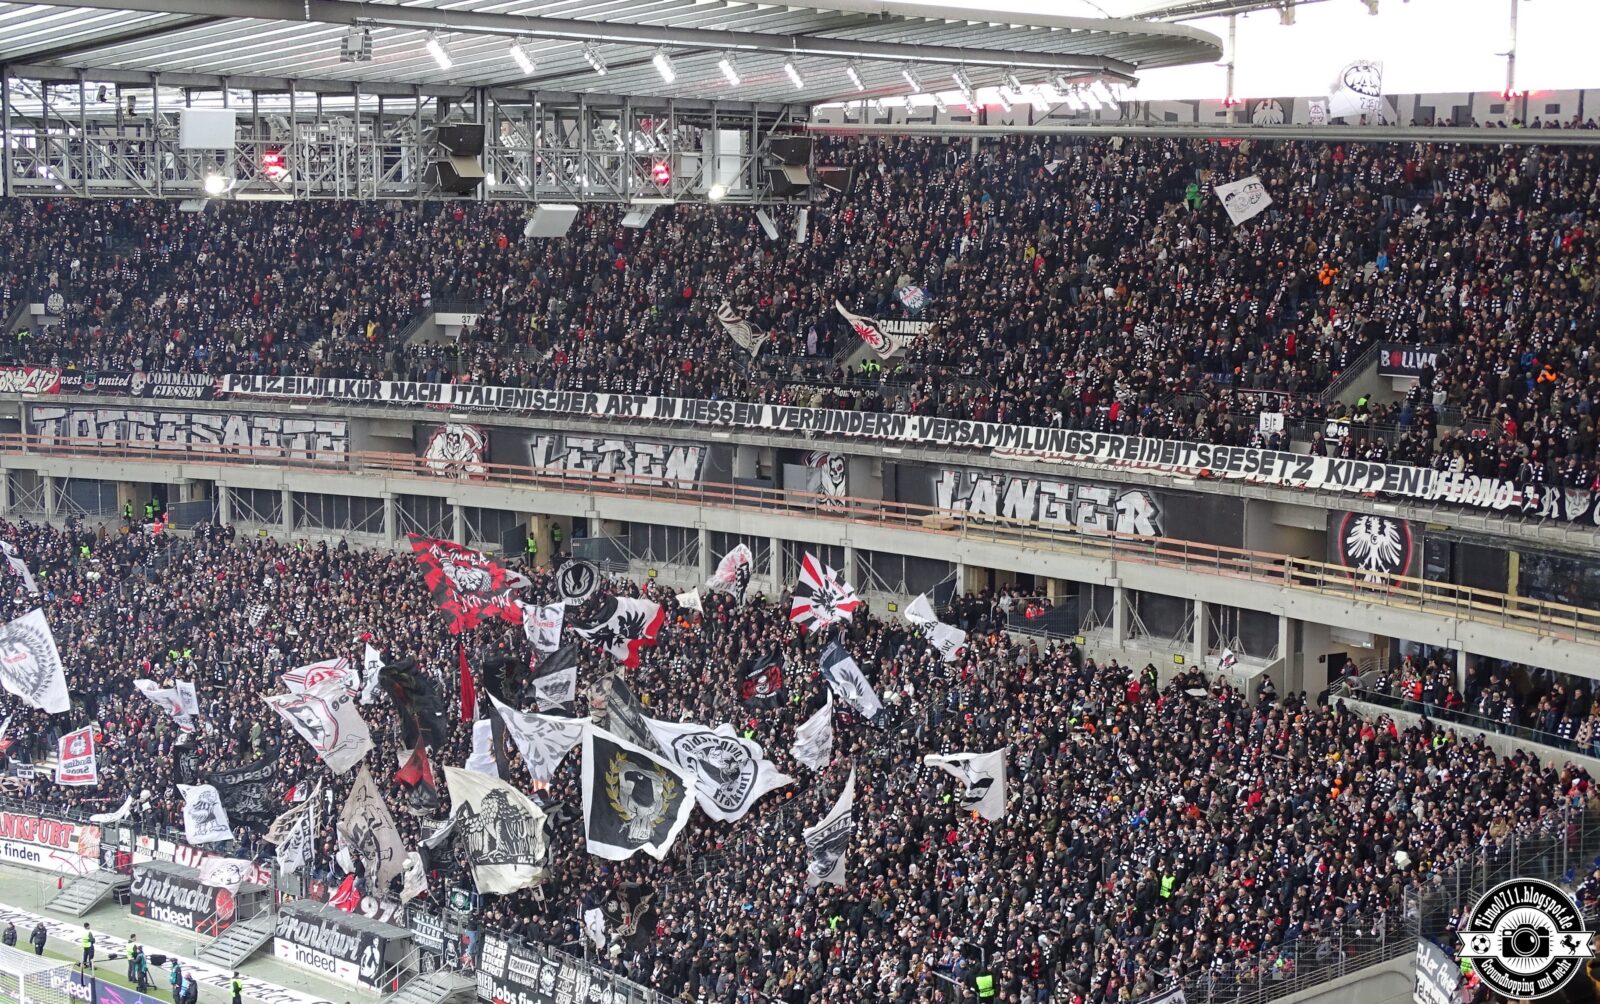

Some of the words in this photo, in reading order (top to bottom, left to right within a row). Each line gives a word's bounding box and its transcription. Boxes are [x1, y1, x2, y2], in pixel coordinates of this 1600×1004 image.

[60, 375, 82, 385] west
[99, 373, 131, 386] united
[146, 371, 214, 387] COMMANDO
[152, 385, 204, 398] GIESSEN
[32, 406, 348, 463] TOTGESAGTE
[228, 373, 381, 399] POLIZEIWILLKÜR
[390, 383, 441, 402] NACH
[450, 385, 598, 415] ITALIENISCHER
[606, 395, 648, 416] ART
[654, 398, 676, 418] IN
[681, 399, 763, 426] HESSEN
[771, 405, 906, 436] VERHINDERN
[918, 416, 1314, 480] VERSAMMLUNGSFREIHEITSGESETZ
[1326, 458, 1432, 497] KIPPEN!
[530, 434, 709, 491] LEBEN
[4, 842, 40, 862] finden
[130, 866, 213, 914] Eintracht
[150, 903, 193, 929] indeed
[416, 923, 441, 939] NEVER
[295, 949, 336, 973] indeed
